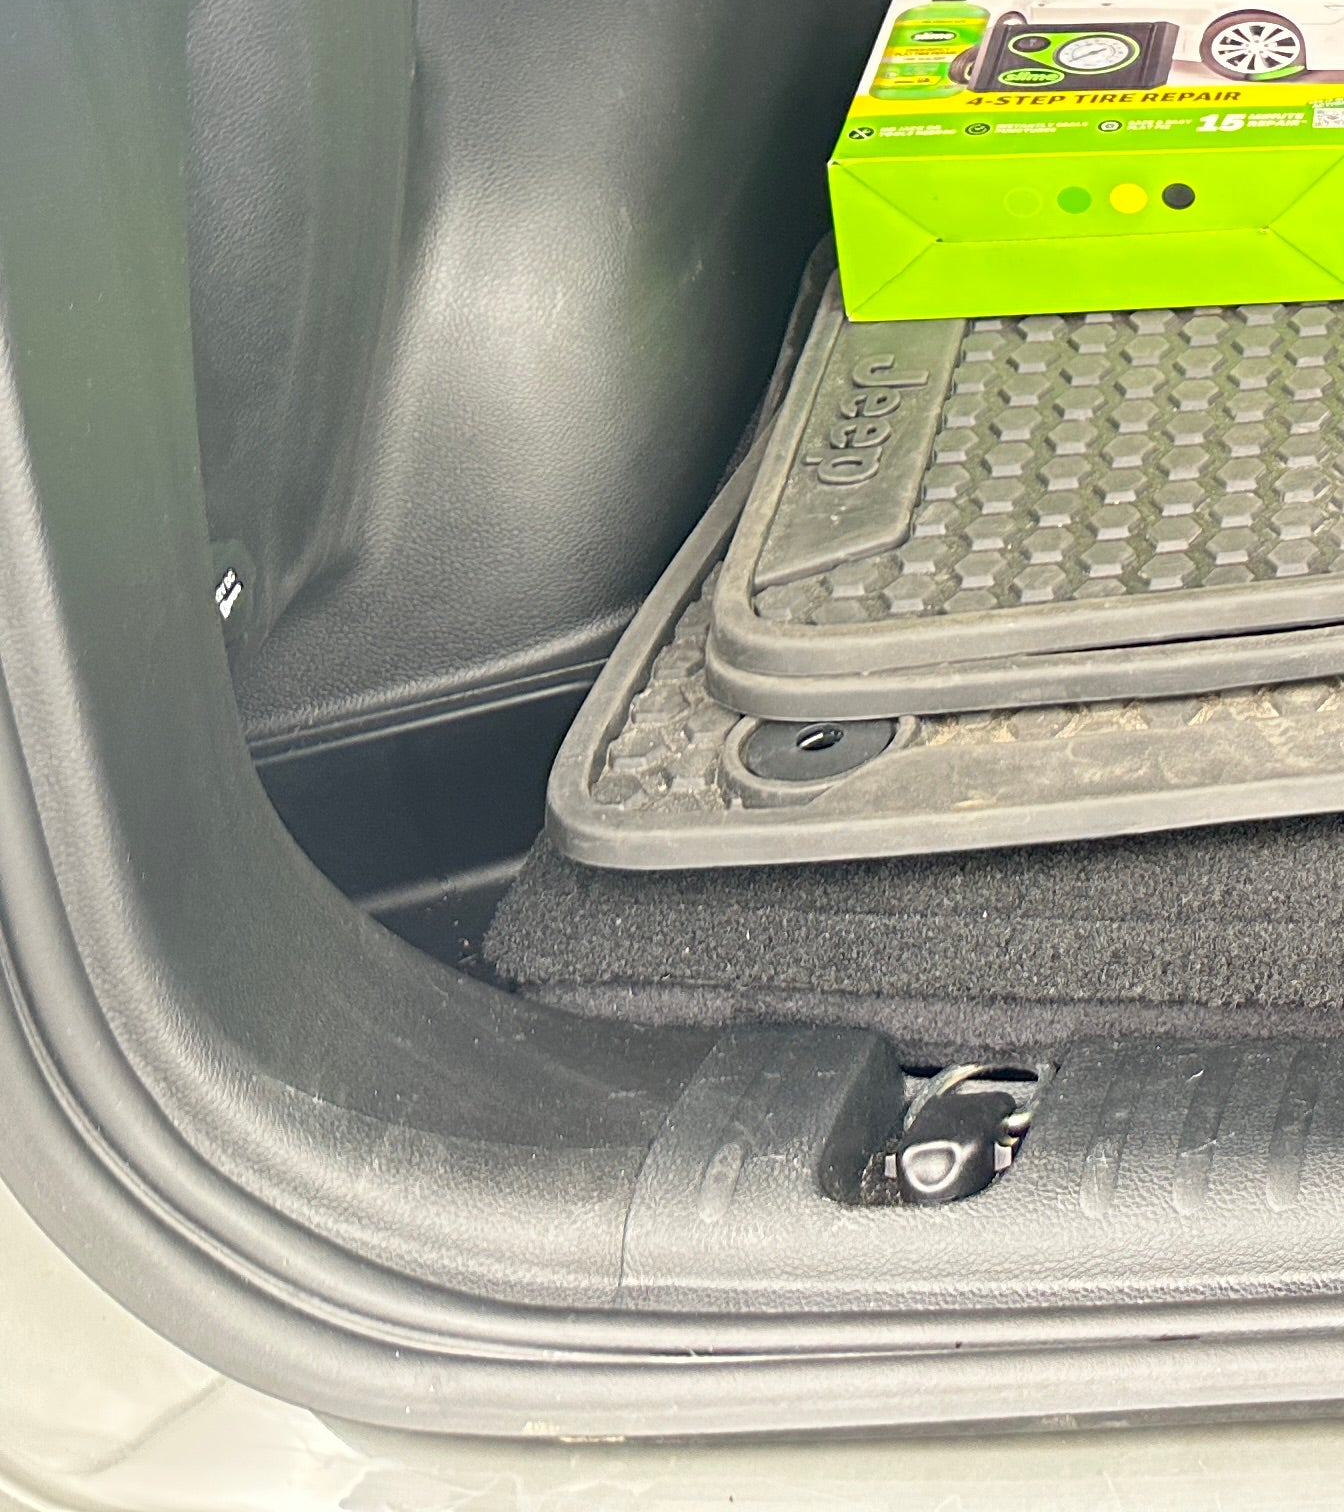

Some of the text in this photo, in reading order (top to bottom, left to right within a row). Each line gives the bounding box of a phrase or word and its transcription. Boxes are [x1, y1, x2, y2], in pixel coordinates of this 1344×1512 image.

[1004, 71, 1060, 82] slime
[966, 91, 1241, 105] 4-STEP TIRE REPAIR
[1196, 113, 1247, 132] 15
[802, 353, 930, 486] Jeep
